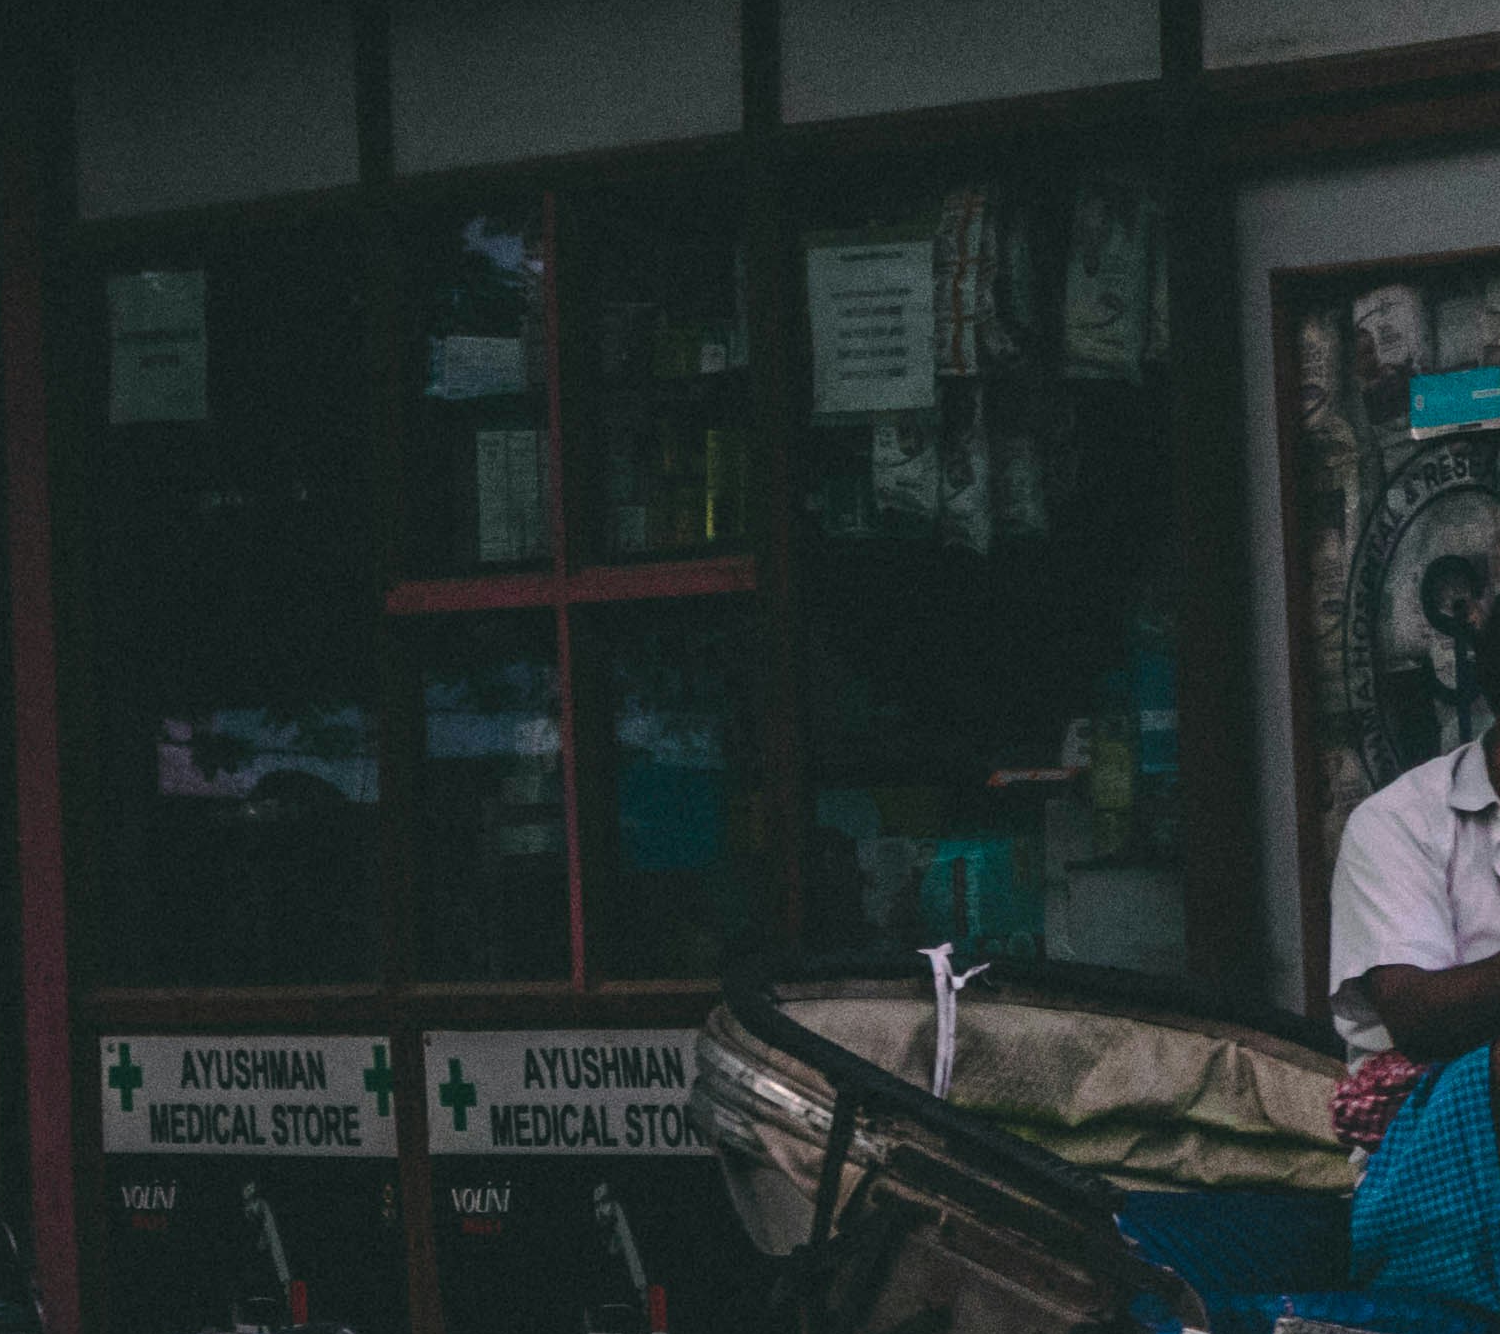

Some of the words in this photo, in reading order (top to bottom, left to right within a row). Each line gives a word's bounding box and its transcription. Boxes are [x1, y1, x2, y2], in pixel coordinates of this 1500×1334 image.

[180, 1048, 328, 1091] AYUSHMAN
[523, 1046, 686, 1091] AYUSHMAN
[149, 1104, 267, 1146] MEDICAL
[271, 1104, 362, 1148] STORE
[490, 1104, 620, 1148] MEDICAL
[624, 1104, 704, 1148] STOR
